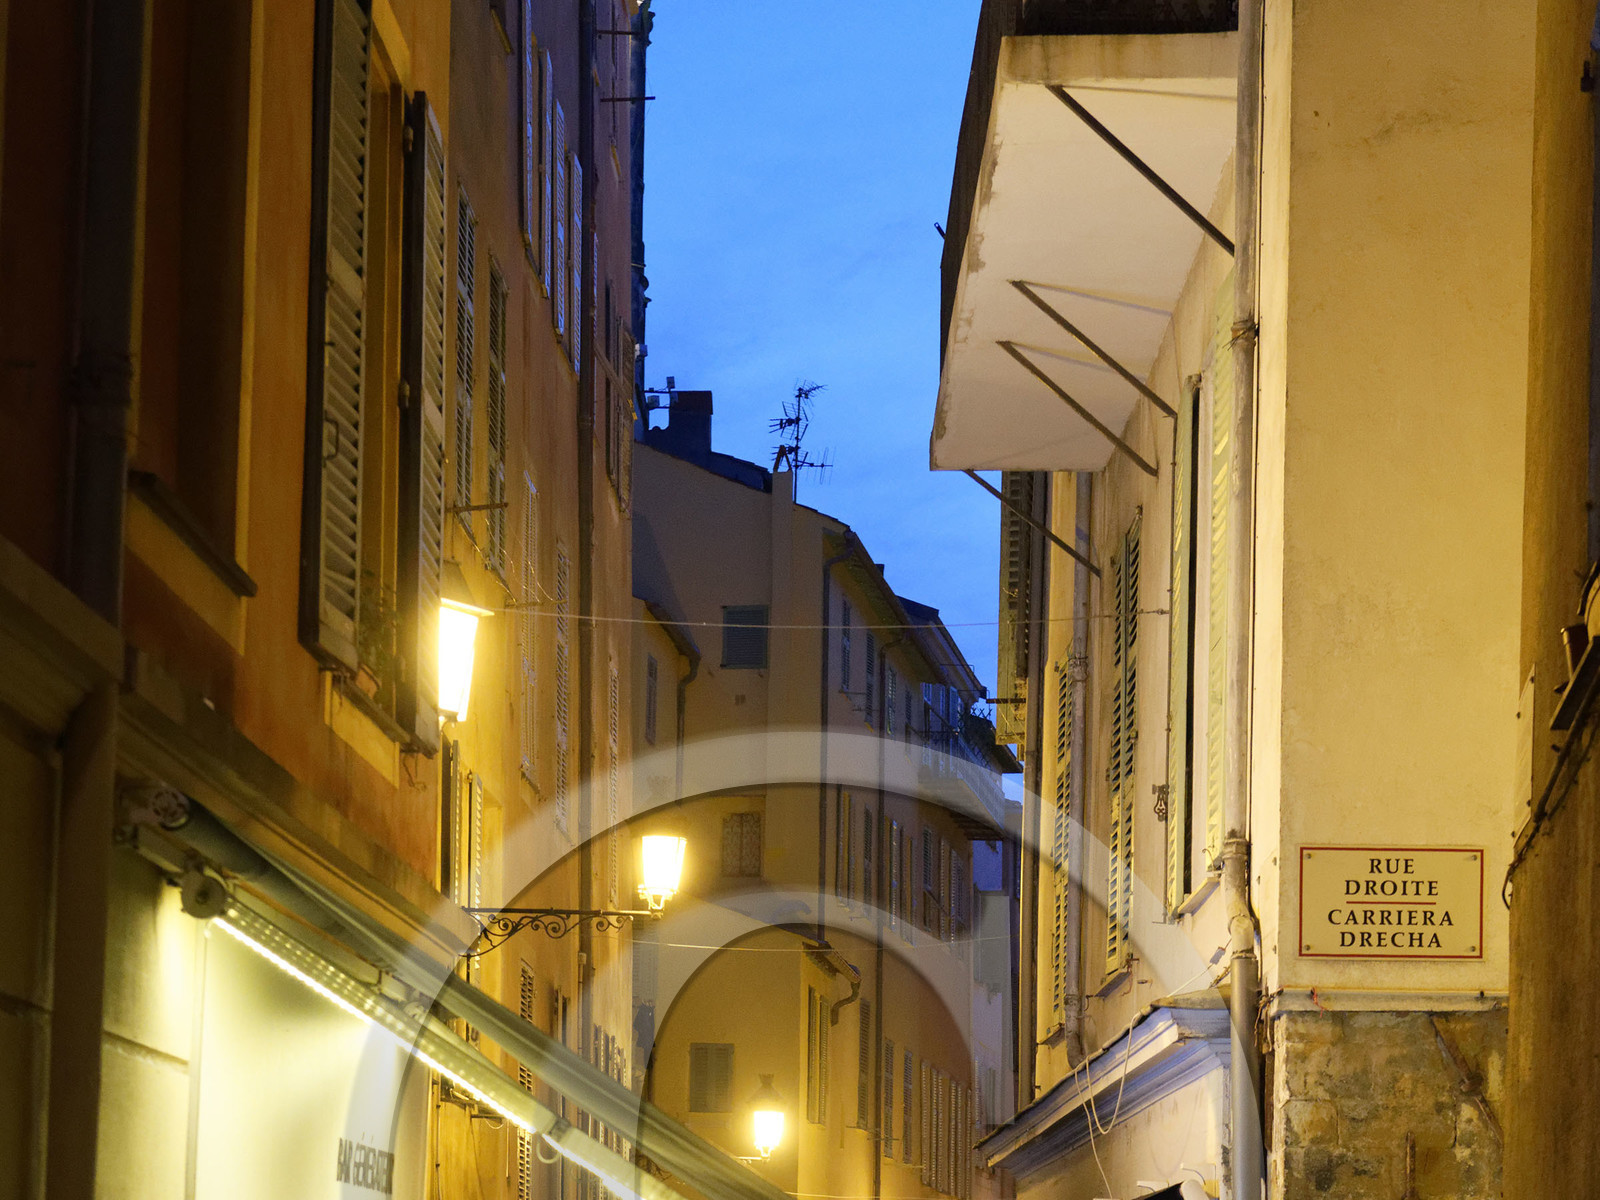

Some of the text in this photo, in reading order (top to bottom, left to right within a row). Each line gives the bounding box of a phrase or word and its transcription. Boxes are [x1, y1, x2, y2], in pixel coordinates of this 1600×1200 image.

[1369, 858, 1415, 875] RUE
[1345, 880, 1439, 897] DROITE
[1328, 909, 1454, 926] CARRIERA
[1340, 931, 1442, 948] DRECHA
